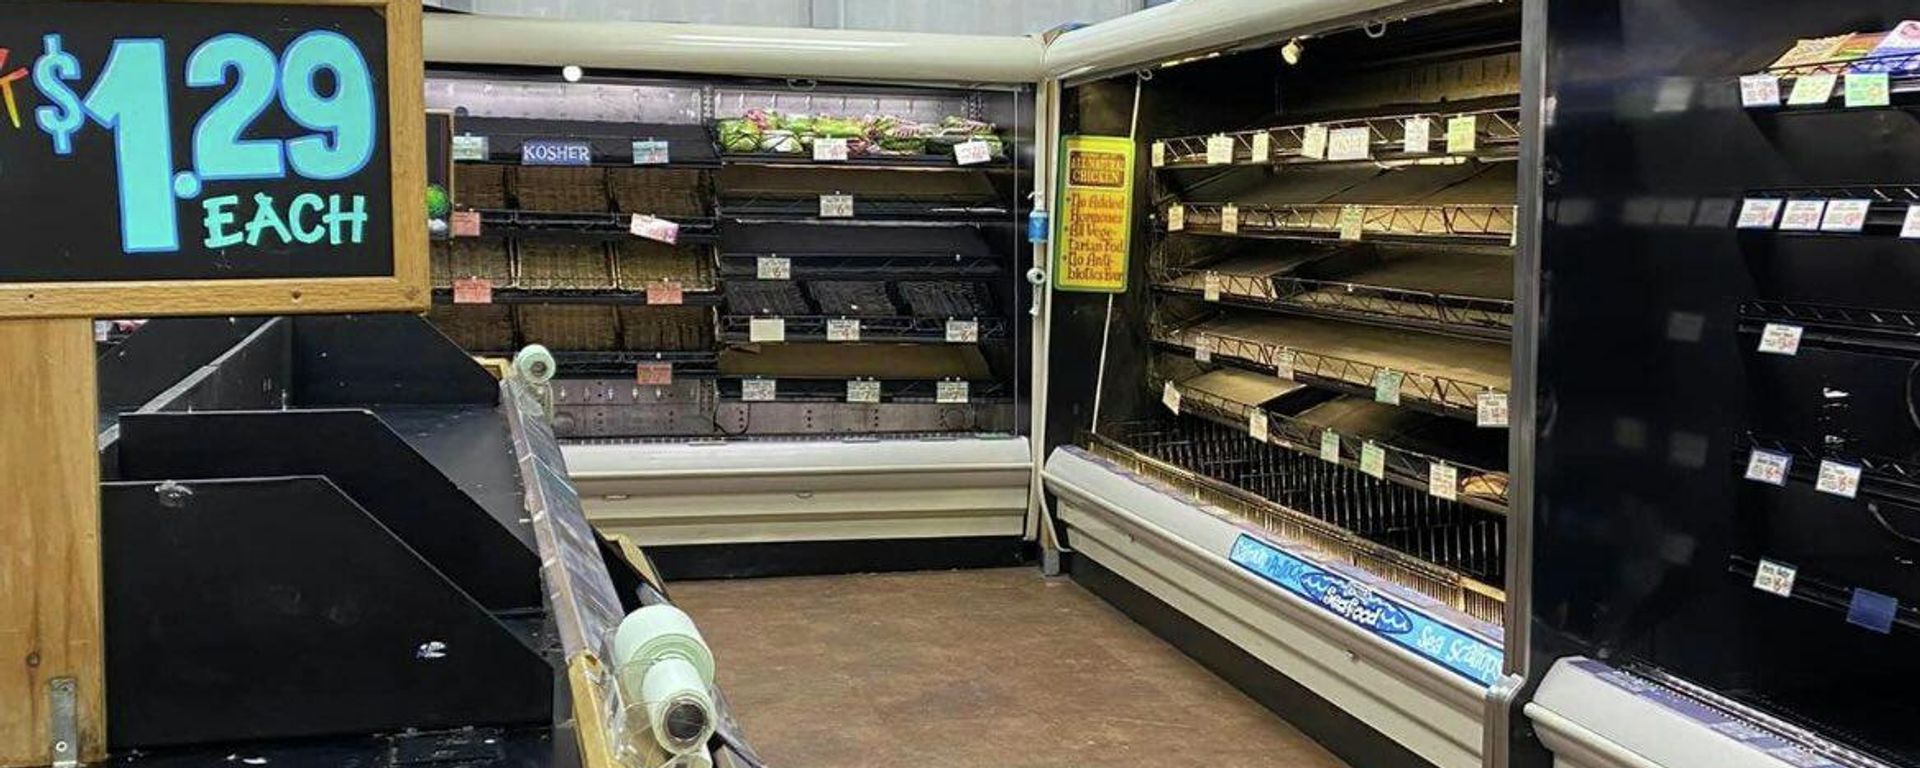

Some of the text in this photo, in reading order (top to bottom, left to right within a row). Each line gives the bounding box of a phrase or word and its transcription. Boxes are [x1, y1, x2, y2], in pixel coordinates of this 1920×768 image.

[33, 29, 377, 254] $1.29
[523, 145, 591, 161] KOSHER
[1072, 170, 1119, 183] CHICKEN
[202, 192, 368, 249] EACH
[1322, 586, 1383, 625] Seafood
[1417, 626, 1446, 656] Sea
